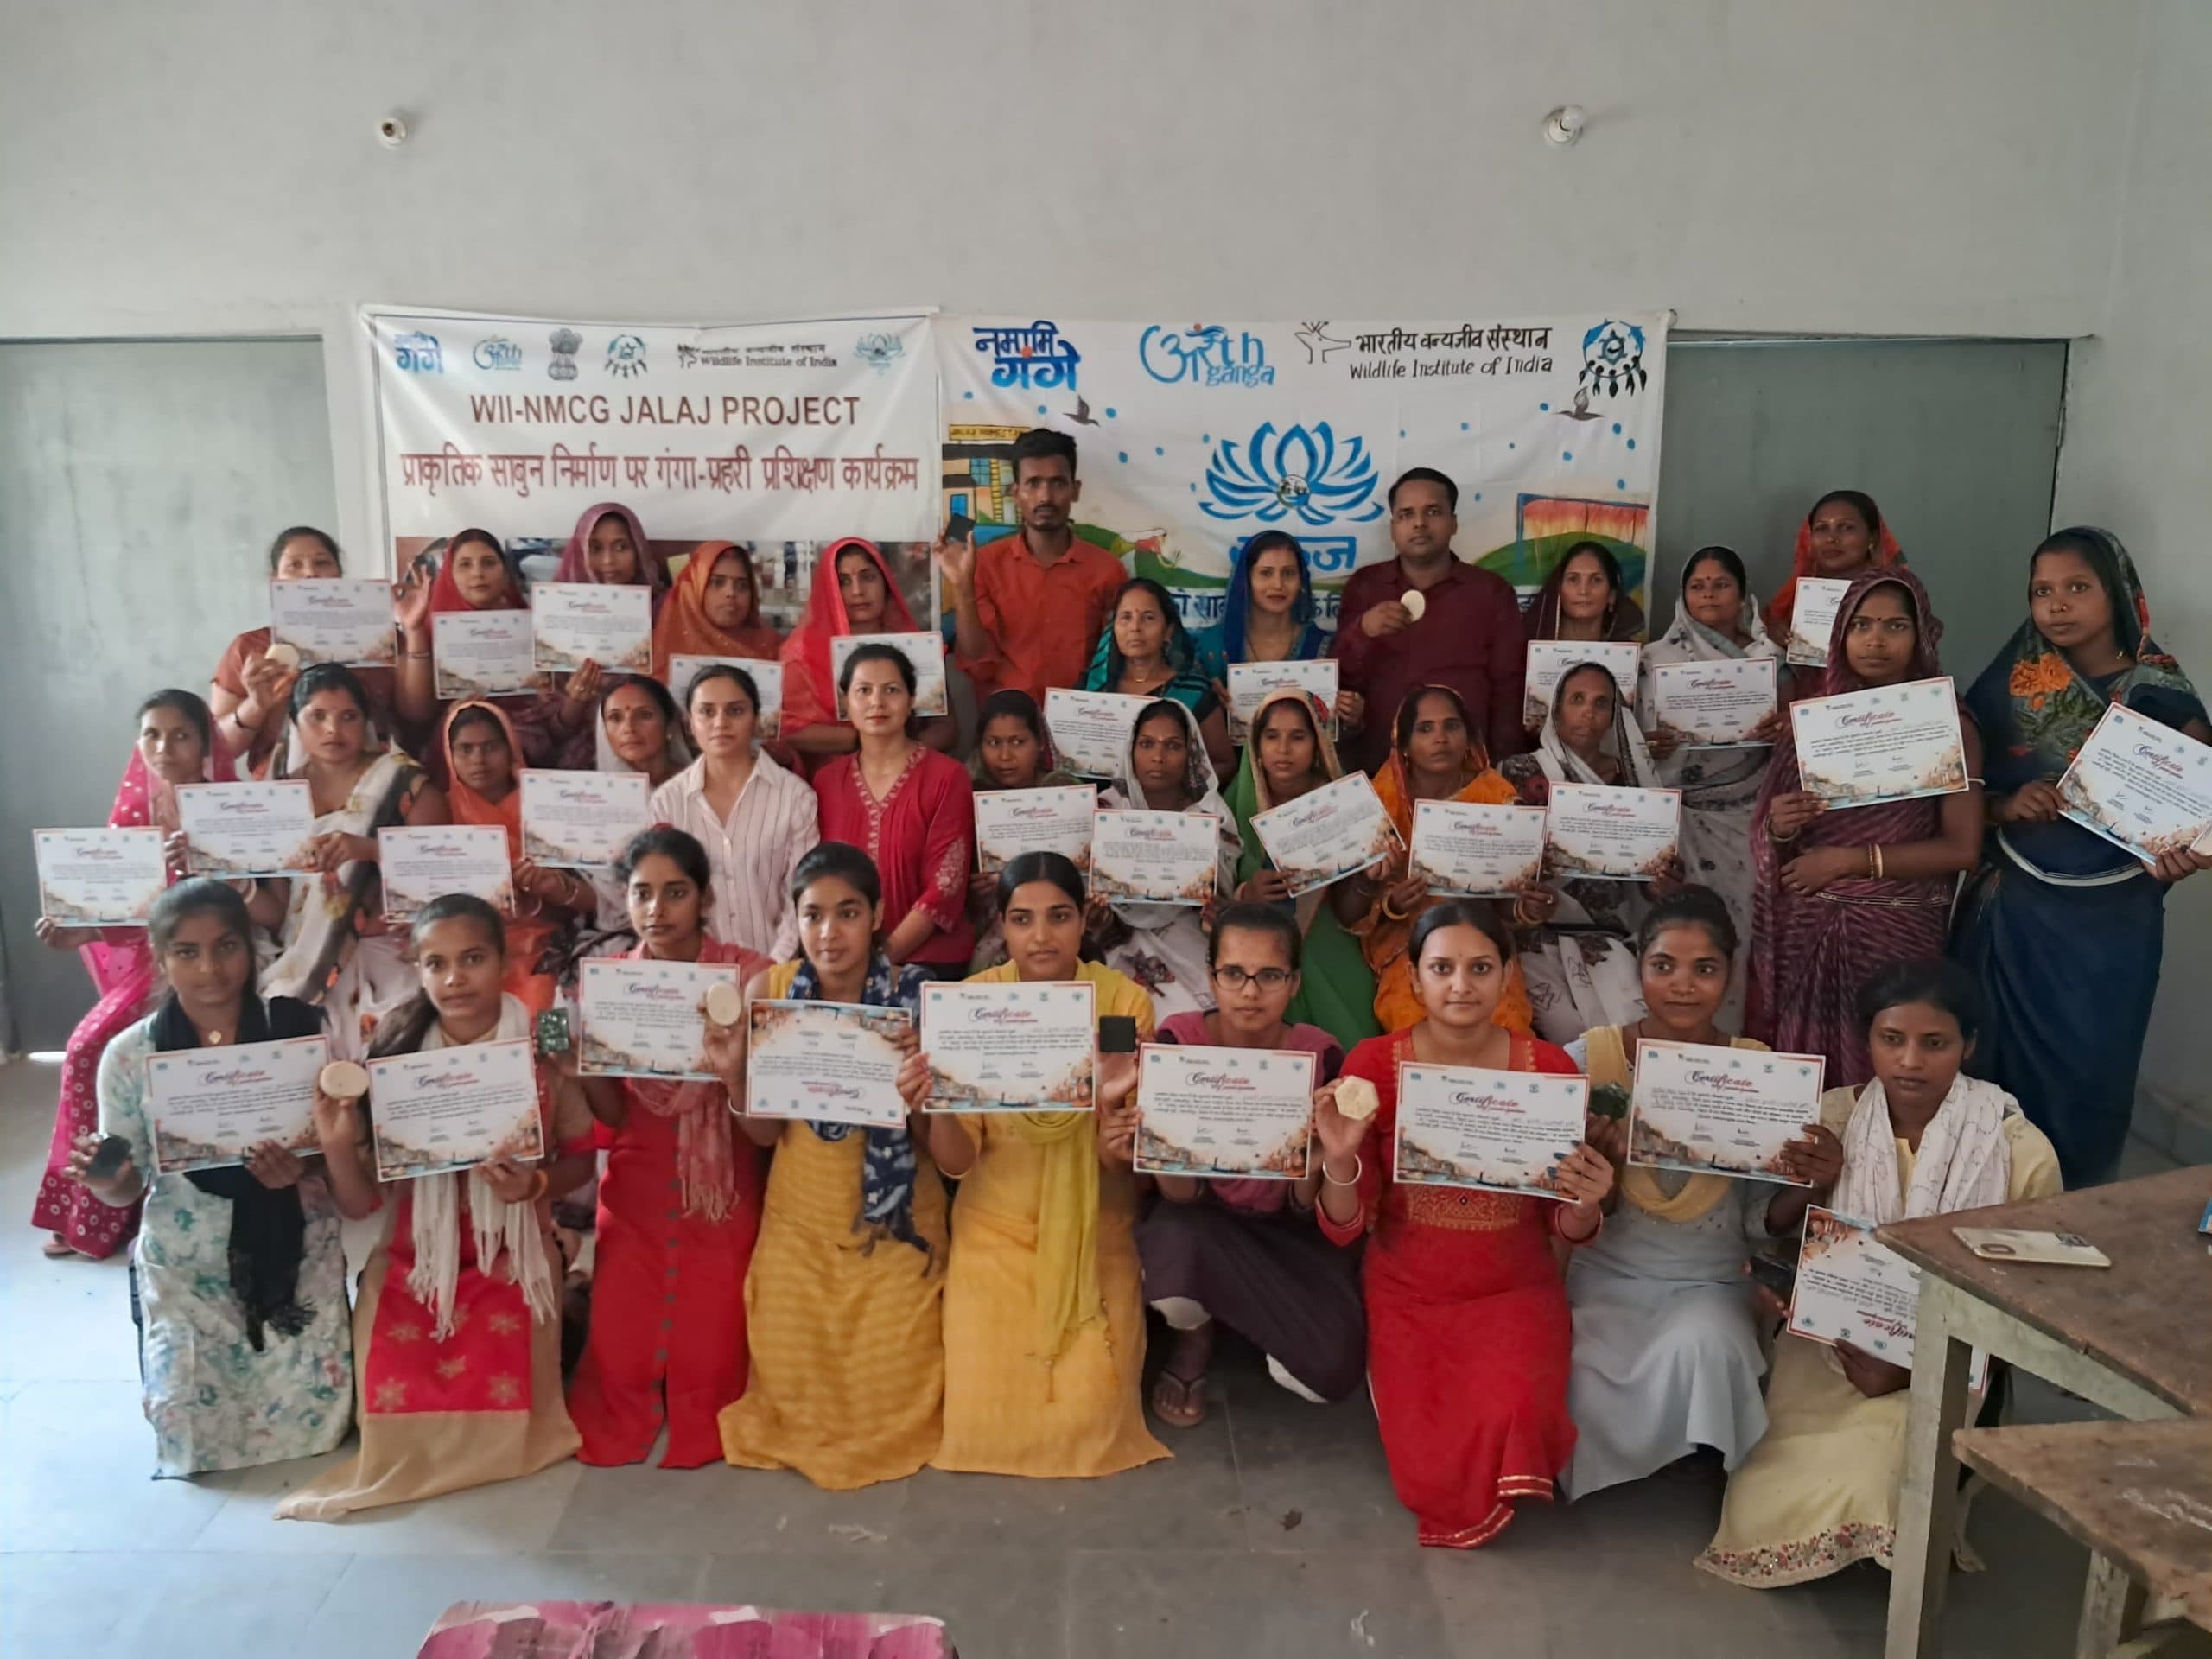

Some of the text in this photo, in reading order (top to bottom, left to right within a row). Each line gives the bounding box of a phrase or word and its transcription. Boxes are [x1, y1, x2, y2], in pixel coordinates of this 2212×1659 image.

[973, 320, 1059, 357] नमामि
[1356, 324, 1553, 354] भारतीय वन्यजीव संस्थान
[701, 356, 837, 367] Wildlife Institute of India
[991, 340, 1081, 391] गंगे
[1205, 365, 1274, 388] ganga
[1350, 355, 1553, 379] Wildlife Institute of India
[470, 395, 860, 425] WII-NMCG JALAJ PROJECT
[400, 442, 483, 497] प्राकृतिक
[488, 454, 545, 498] साबुन
[551, 442, 618, 487] निर्माण
[624, 456, 650, 488] पर
[761, 444, 836, 494] प्रशिक्षण
[841, 443, 919, 491] कार्यक्रम
